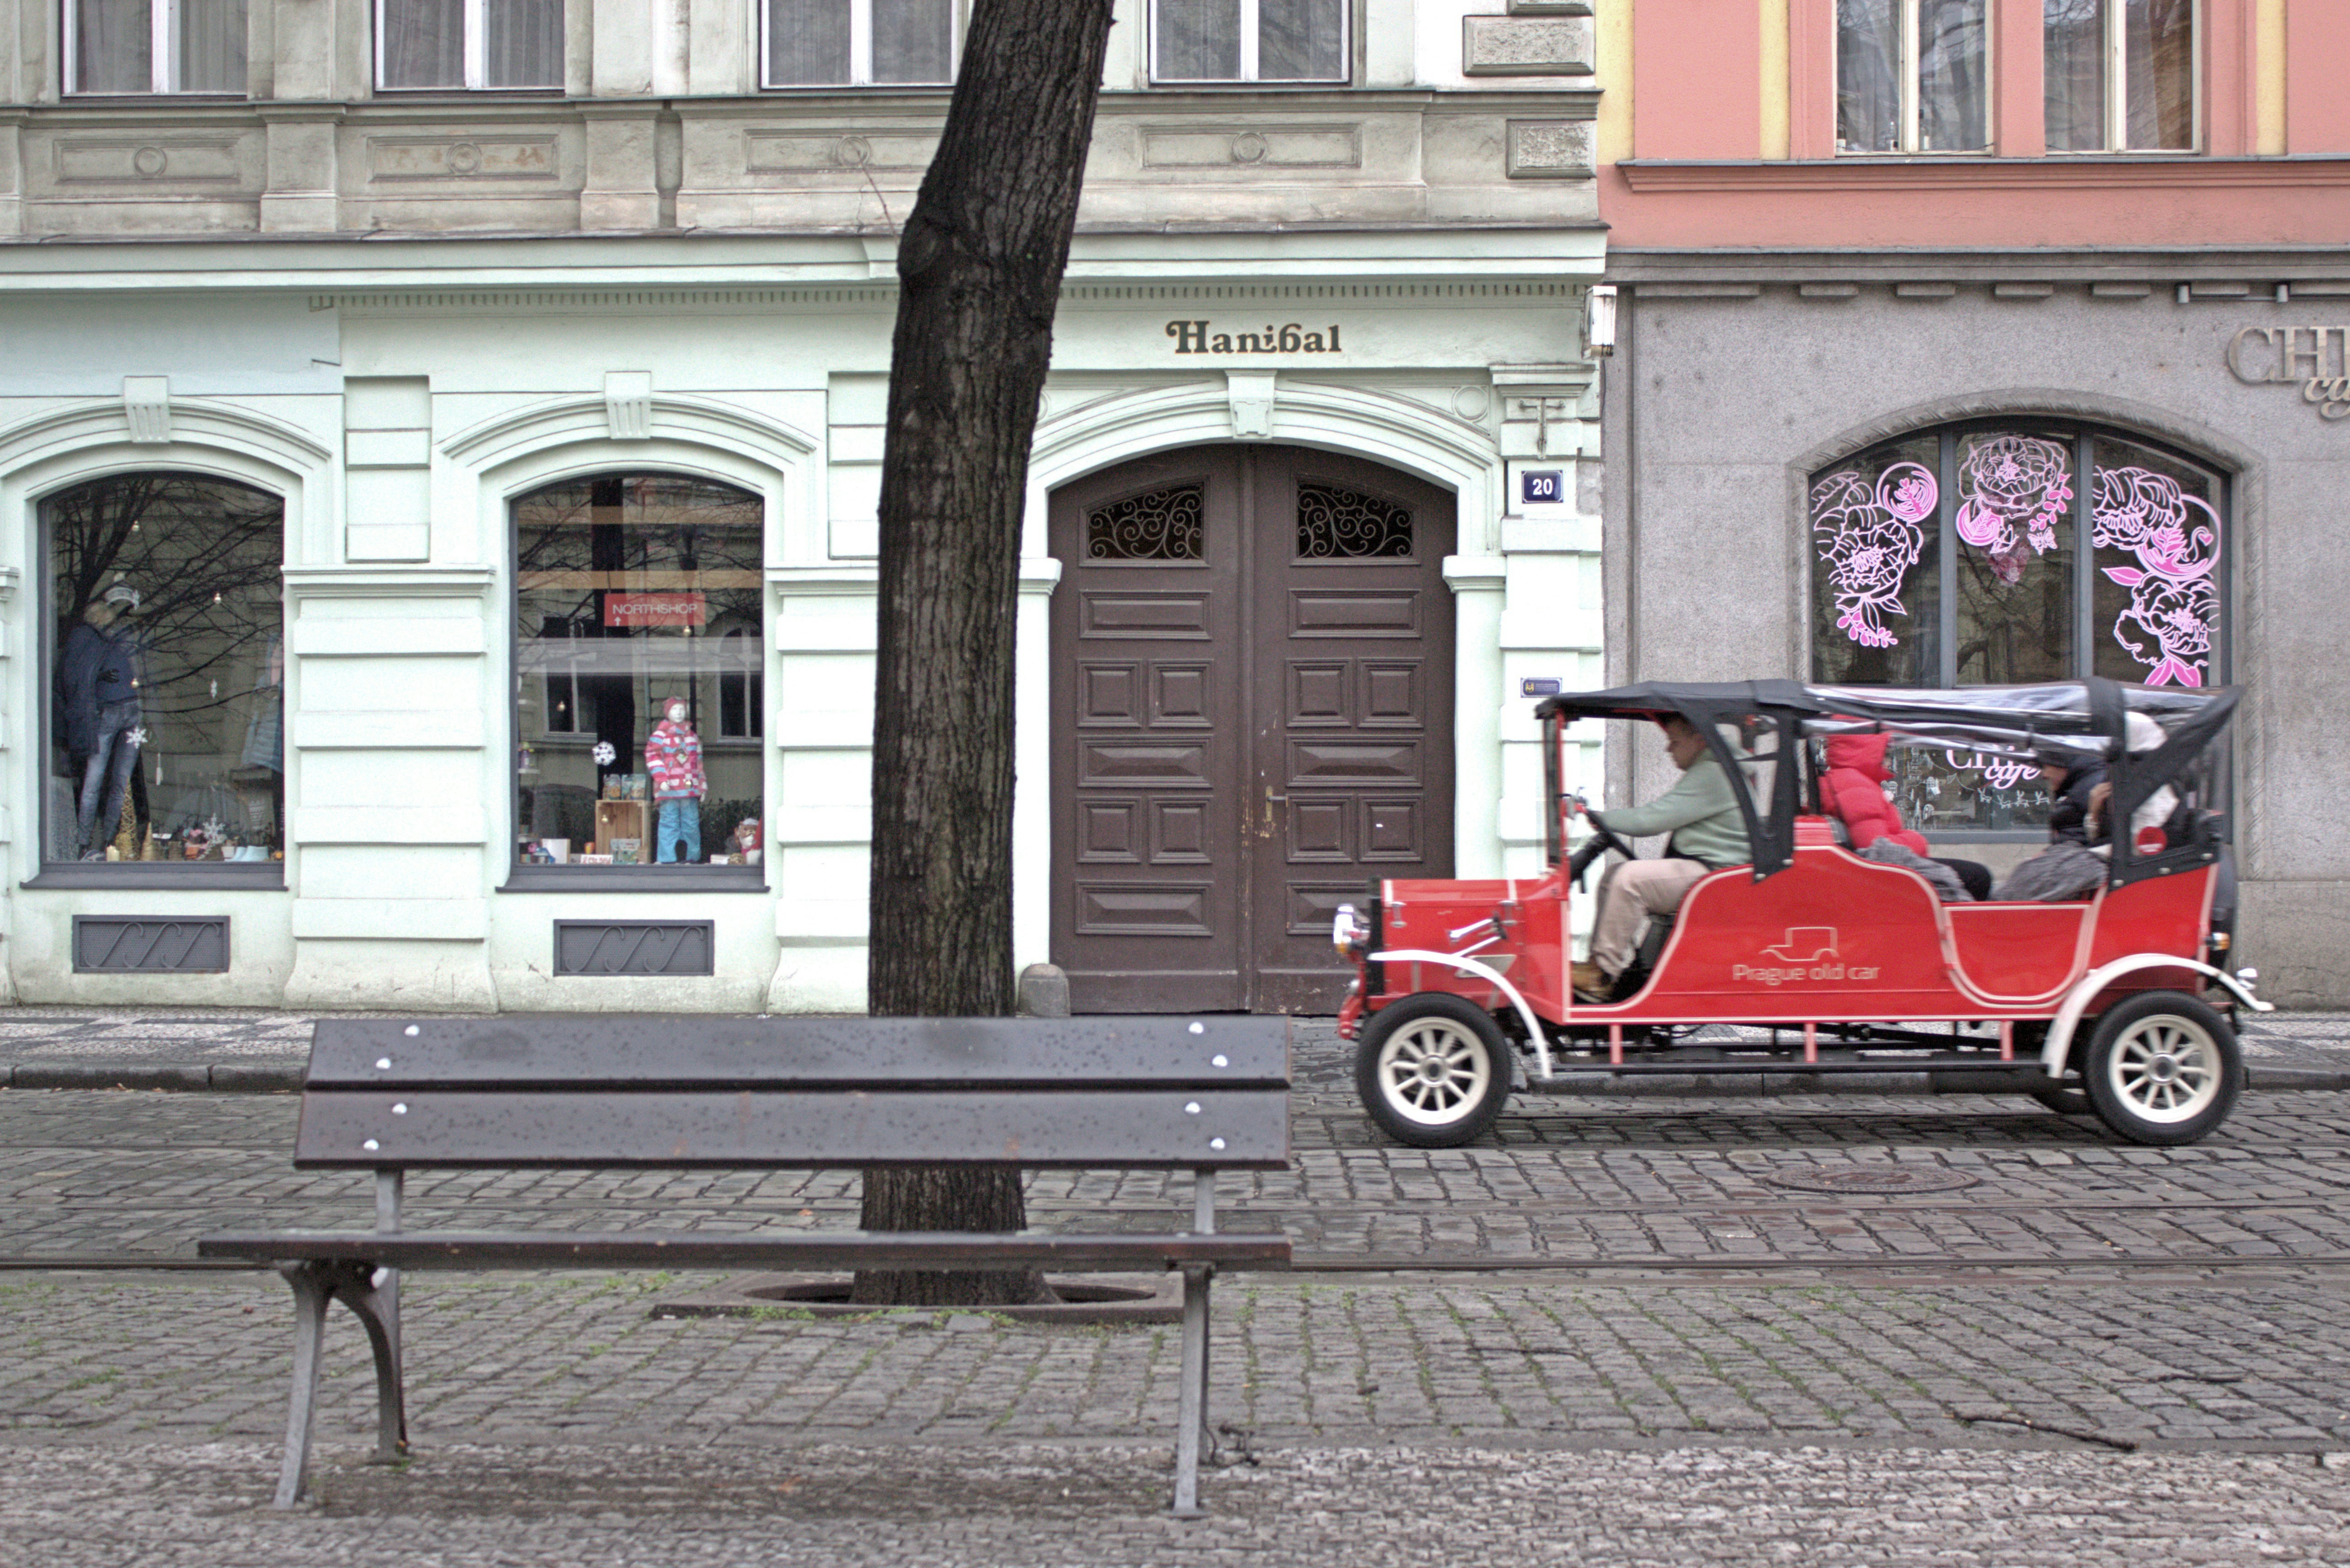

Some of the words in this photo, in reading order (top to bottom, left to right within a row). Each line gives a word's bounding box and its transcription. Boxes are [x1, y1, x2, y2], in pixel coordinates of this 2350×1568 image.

[1165, 320, 1342, 354] Hanibal
[1533, 478, 1553, 495] 20
[613, 604, 697, 614] NORTHSHOP
[1732, 964, 1806, 986] Prague
[1809, 963, 1845, 979] old
[1847, 967, 1881, 979] car
